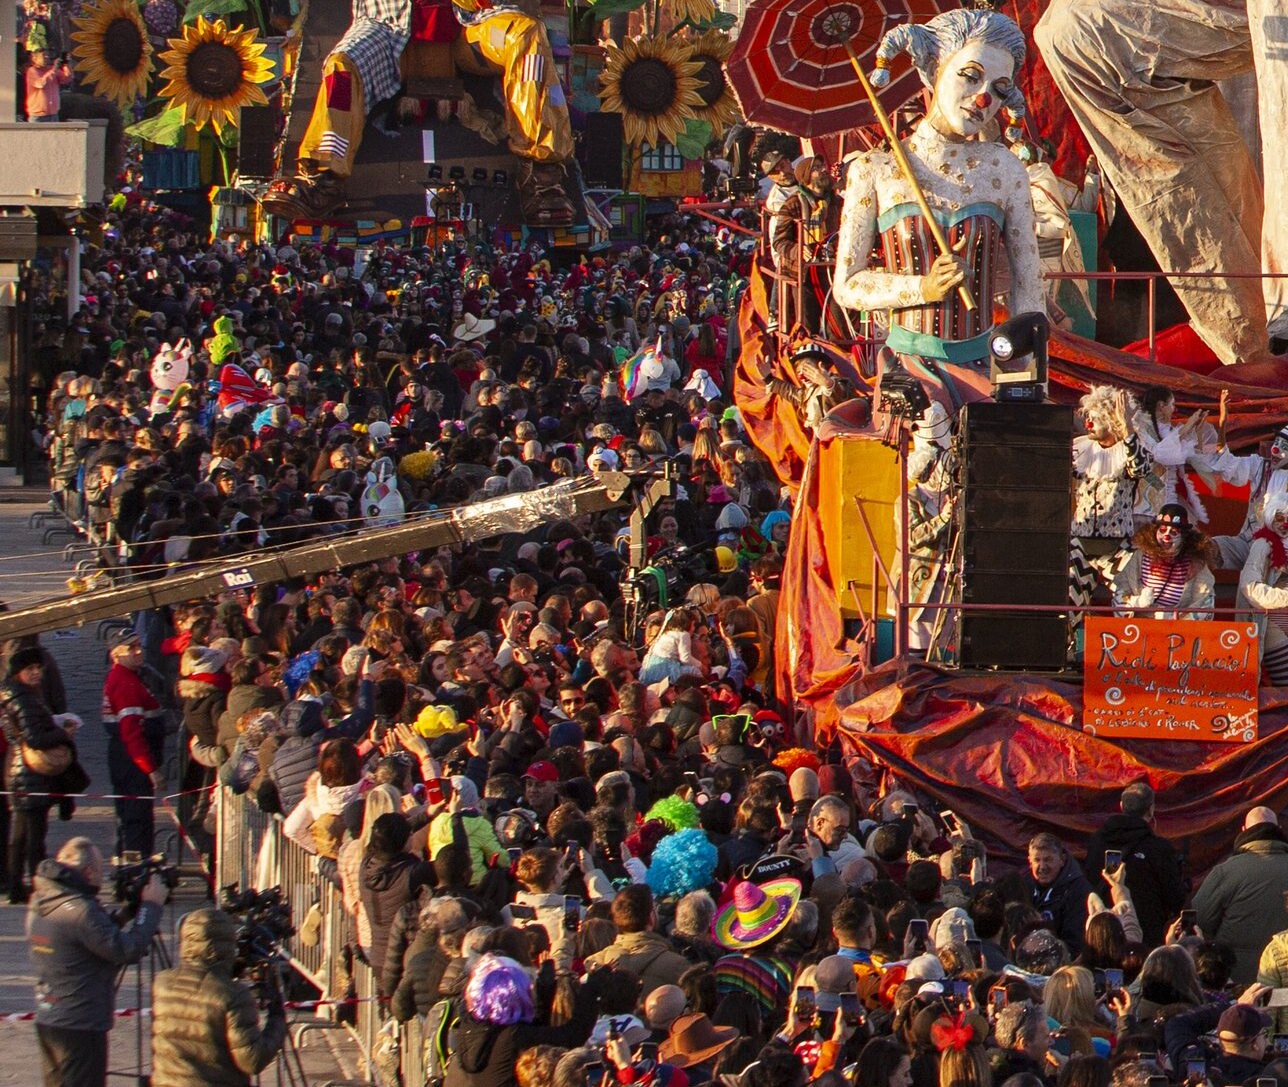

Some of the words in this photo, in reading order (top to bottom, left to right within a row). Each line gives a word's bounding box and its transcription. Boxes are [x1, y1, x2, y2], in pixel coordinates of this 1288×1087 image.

[223, 569, 254, 586] Rai
[1097, 632, 1157, 671] Ridi
[757, 859, 791, 873] BOUNTY
